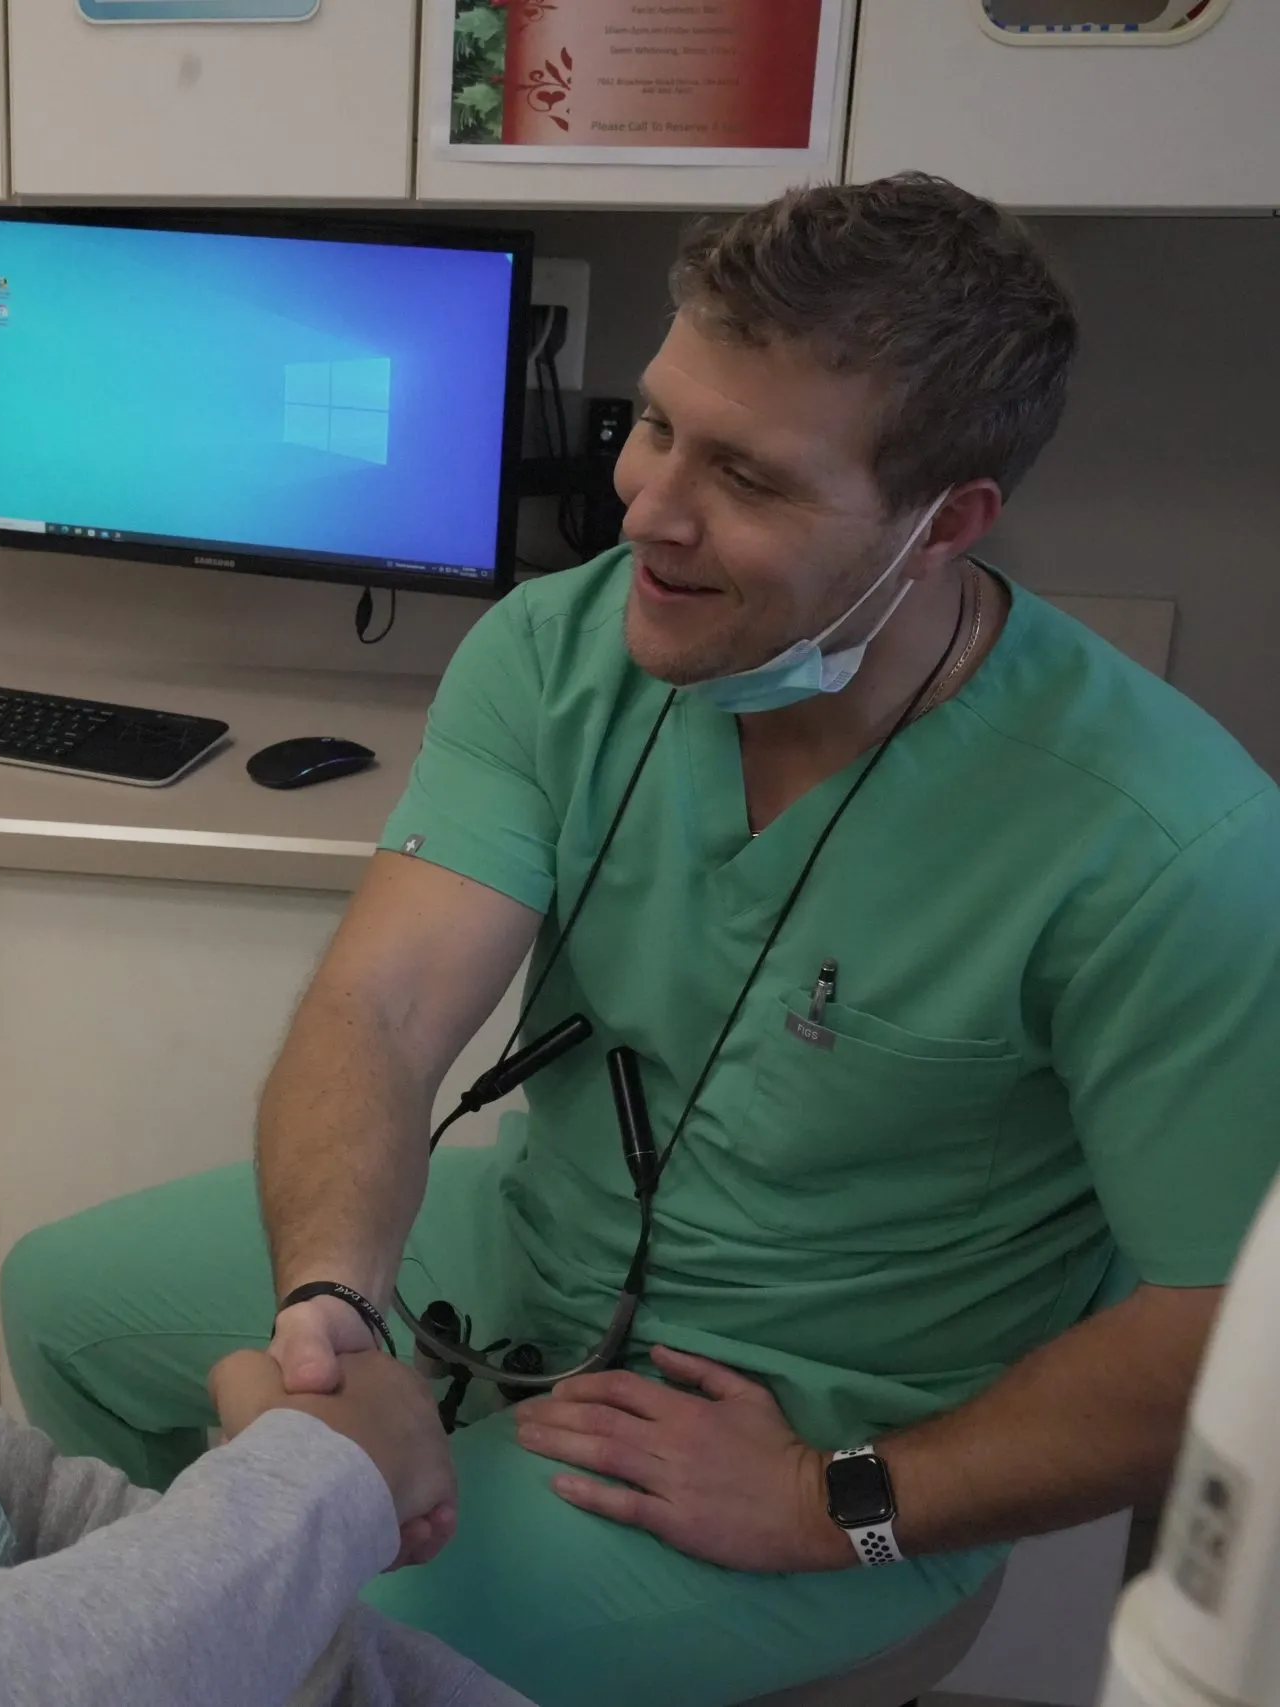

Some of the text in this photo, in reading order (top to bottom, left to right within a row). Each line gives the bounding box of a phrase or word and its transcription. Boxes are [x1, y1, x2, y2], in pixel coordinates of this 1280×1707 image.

[591, 120, 625, 131] Please
[628, 120, 648, 131] Call
[651, 121, 663, 132] To
[665, 121, 708, 132] Reserve
[797, 1023, 819, 1040] FIGS
